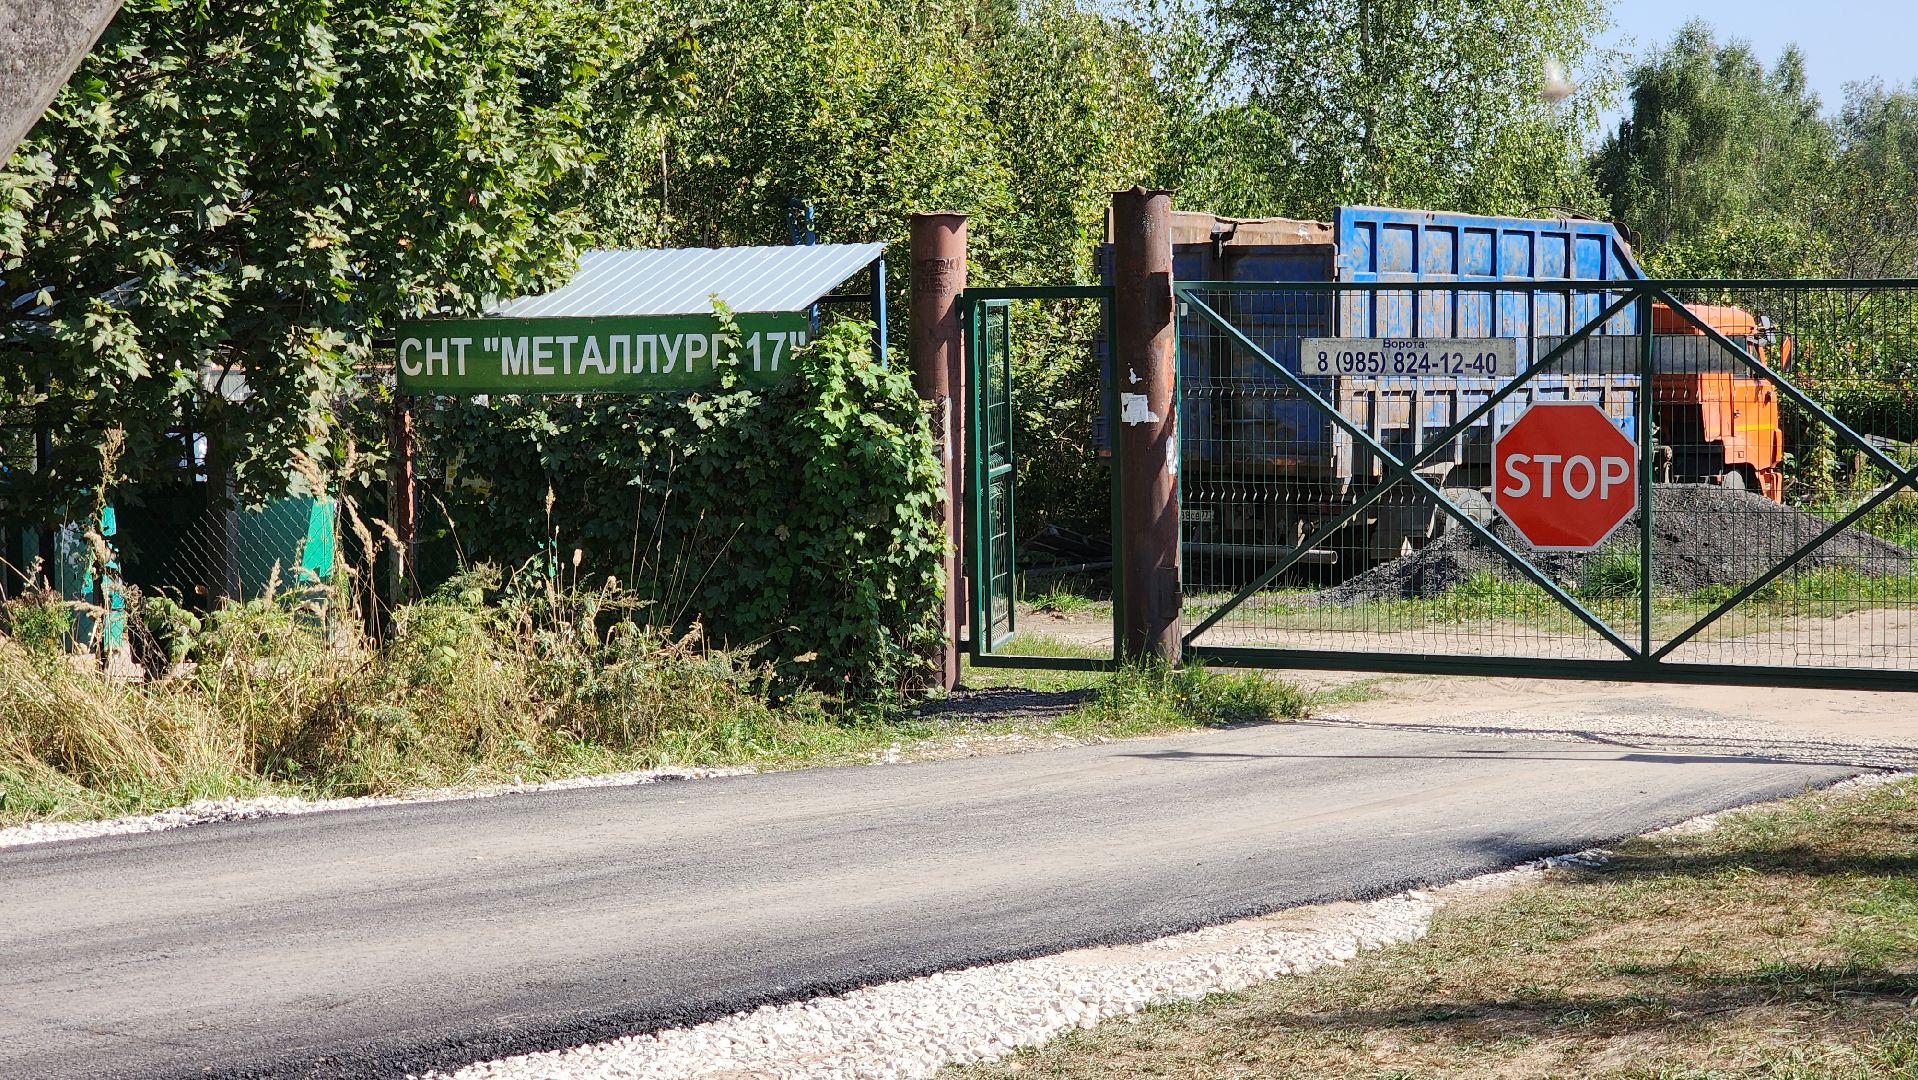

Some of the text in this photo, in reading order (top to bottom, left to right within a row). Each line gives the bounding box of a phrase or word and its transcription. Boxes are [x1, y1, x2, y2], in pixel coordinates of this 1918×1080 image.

[399, 336, 472, 376] СНТ
[746, 331, 806, 372] 17"
[1382, 338, 1428, 351] Ворота:
[1317, 351, 1497, 374] 8 (985) 824-12-40
[1502, 453, 1630, 500] STOP
